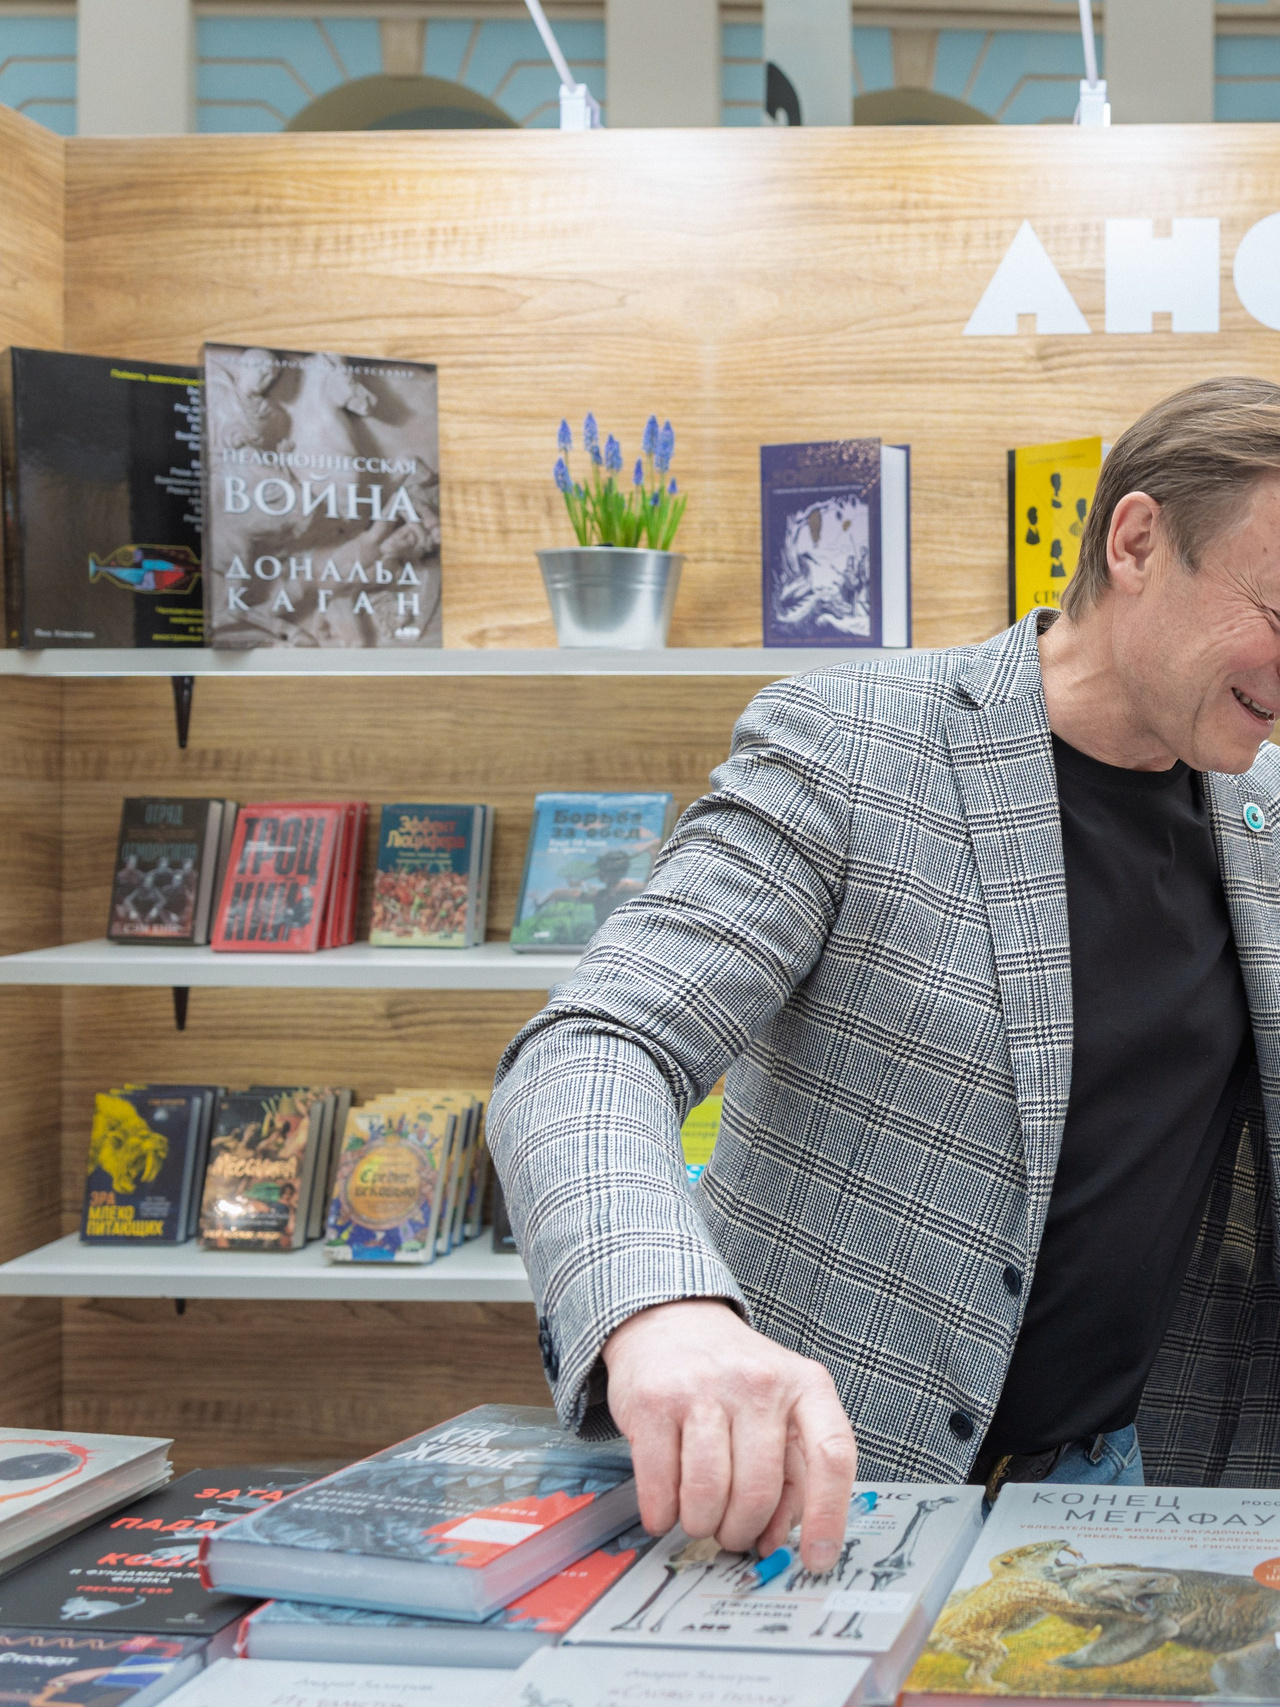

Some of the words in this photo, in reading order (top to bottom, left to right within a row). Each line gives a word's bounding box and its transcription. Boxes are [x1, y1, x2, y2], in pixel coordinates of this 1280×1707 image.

[222, 448, 417, 475] ПЕЛОПОННЕССКАЯ
[223, 472, 422, 523] ВОЙНА
[224, 554, 422, 586] ДОНАЛЬД
[227, 586, 421, 617] КАГАН
[553, 808, 644, 826] Борьба
[87, 1205, 136, 1222] МЛЕКО
[85, 1219, 165, 1238] ПИТАЮЩИХ
[428, 1426, 511, 1447] КАК
[391, 1442, 539, 1469] ЖИВЫЕ
[195, 1487, 285, 1502] ЗАГА
[1032, 1492, 1181, 1510] КОНЕЦ
[110, 1516, 217, 1532] ПАДА
[1020, 1523, 1119, 1532] УВЛЕКАТЕЛЬНАЯ
[1184, 1528, 1260, 1536] ЗАГАДОЧНАЯ
[1202, 1543, 1280, 1551] ГИГАНТСКИХ
[97, 1551, 200, 1568] КОШ
[86, 1568, 202, 1579] ФУНДАМЕНТАЛЬ
[111, 1576, 171, 1585] ФИЗИКА
